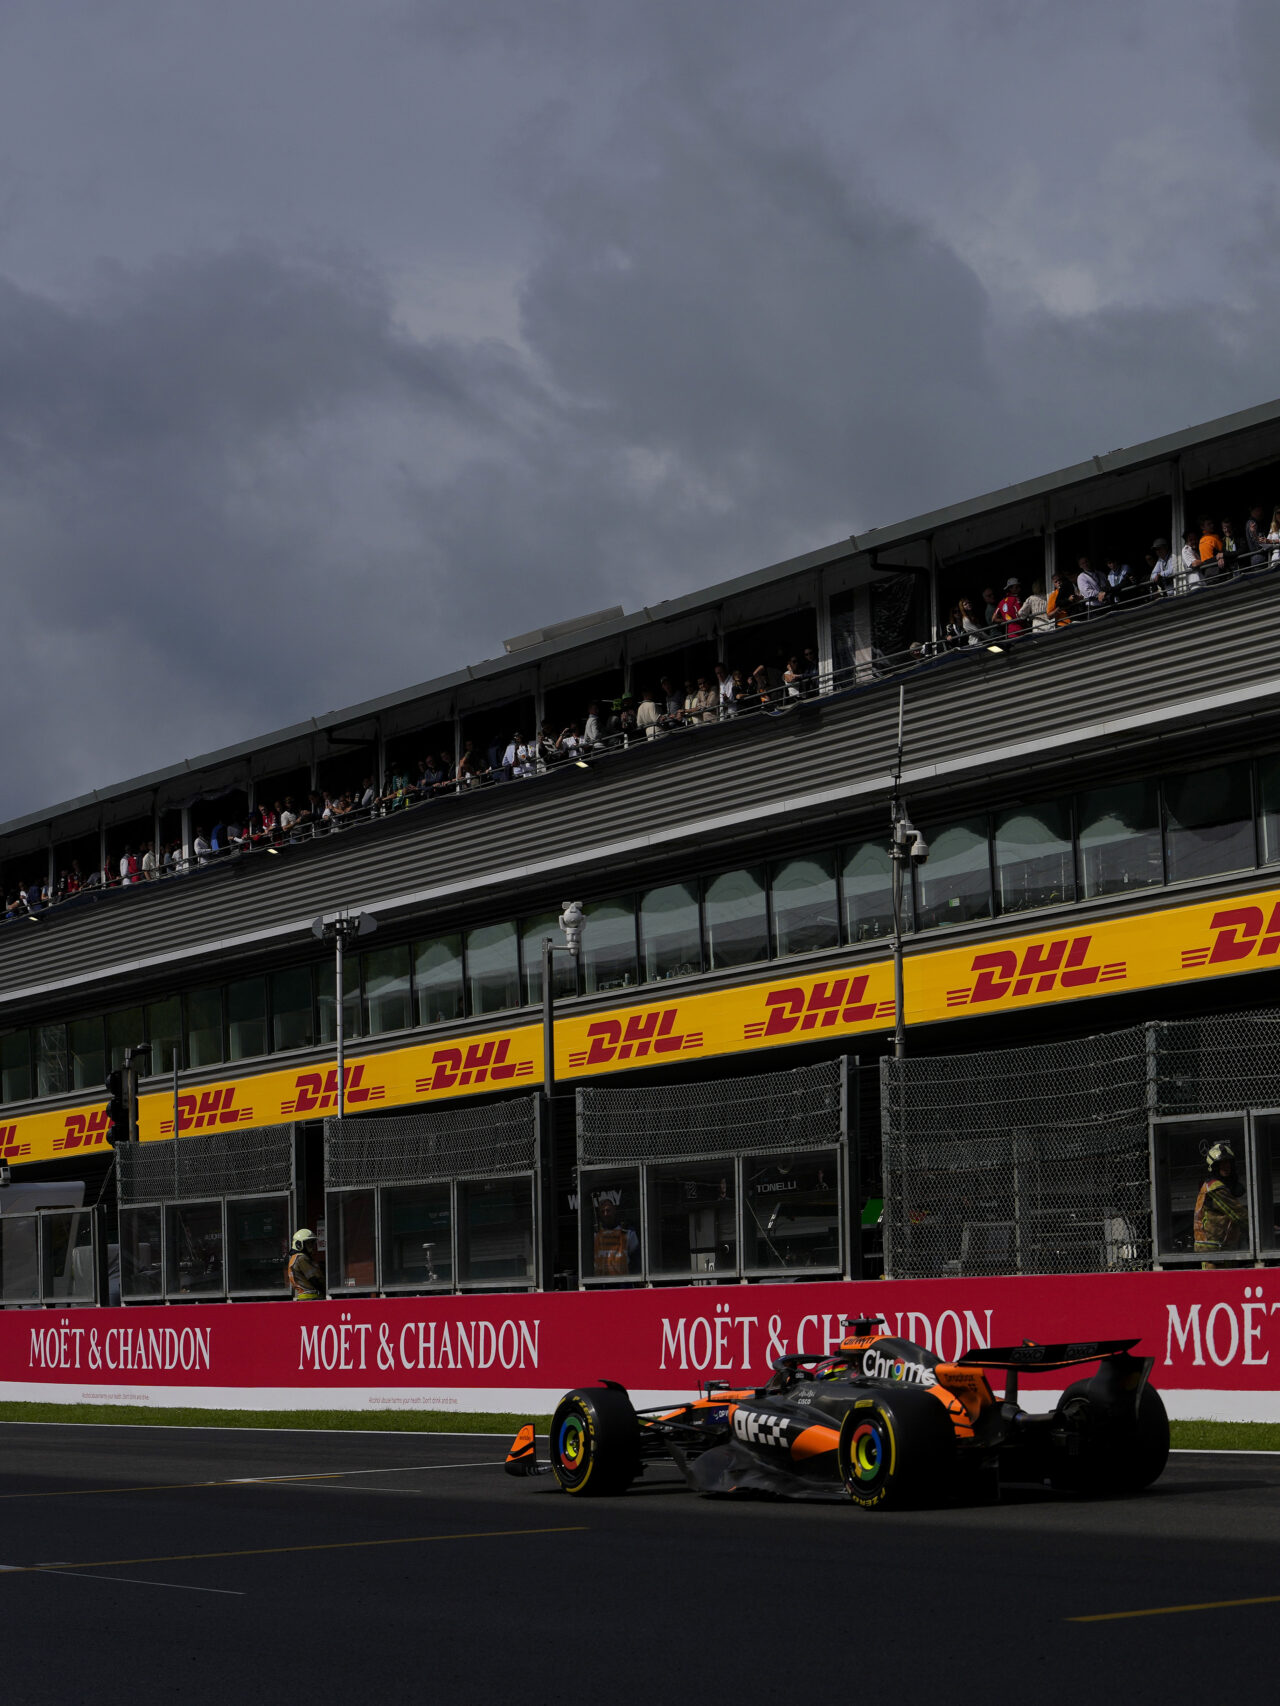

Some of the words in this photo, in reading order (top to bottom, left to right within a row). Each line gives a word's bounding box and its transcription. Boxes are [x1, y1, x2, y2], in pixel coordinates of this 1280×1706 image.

[971, 936, 1101, 1004] DHL
[765, 976, 876, 1037] DHL
[586, 1010, 685, 1065] DHL
[295, 1065, 372, 1112] DHL
[430, 1039, 517, 1093] DHL
[64, 1114, 110, 1149] DH
[172, 1088, 240, 1131] DHL
[29, 1319, 86, 1370] MOËT
[88, 1328, 103, 1371] &
[105, 1328, 212, 1371] CHANDON
[298, 1313, 373, 1371] MOËT
[376, 1322, 395, 1371] &
[399, 1320, 541, 1371] CHANDON
[659, 1303, 759, 1371] MOËT
[766, 1314, 790, 1371] &
[862, 1349, 938, 1386] Chrome
